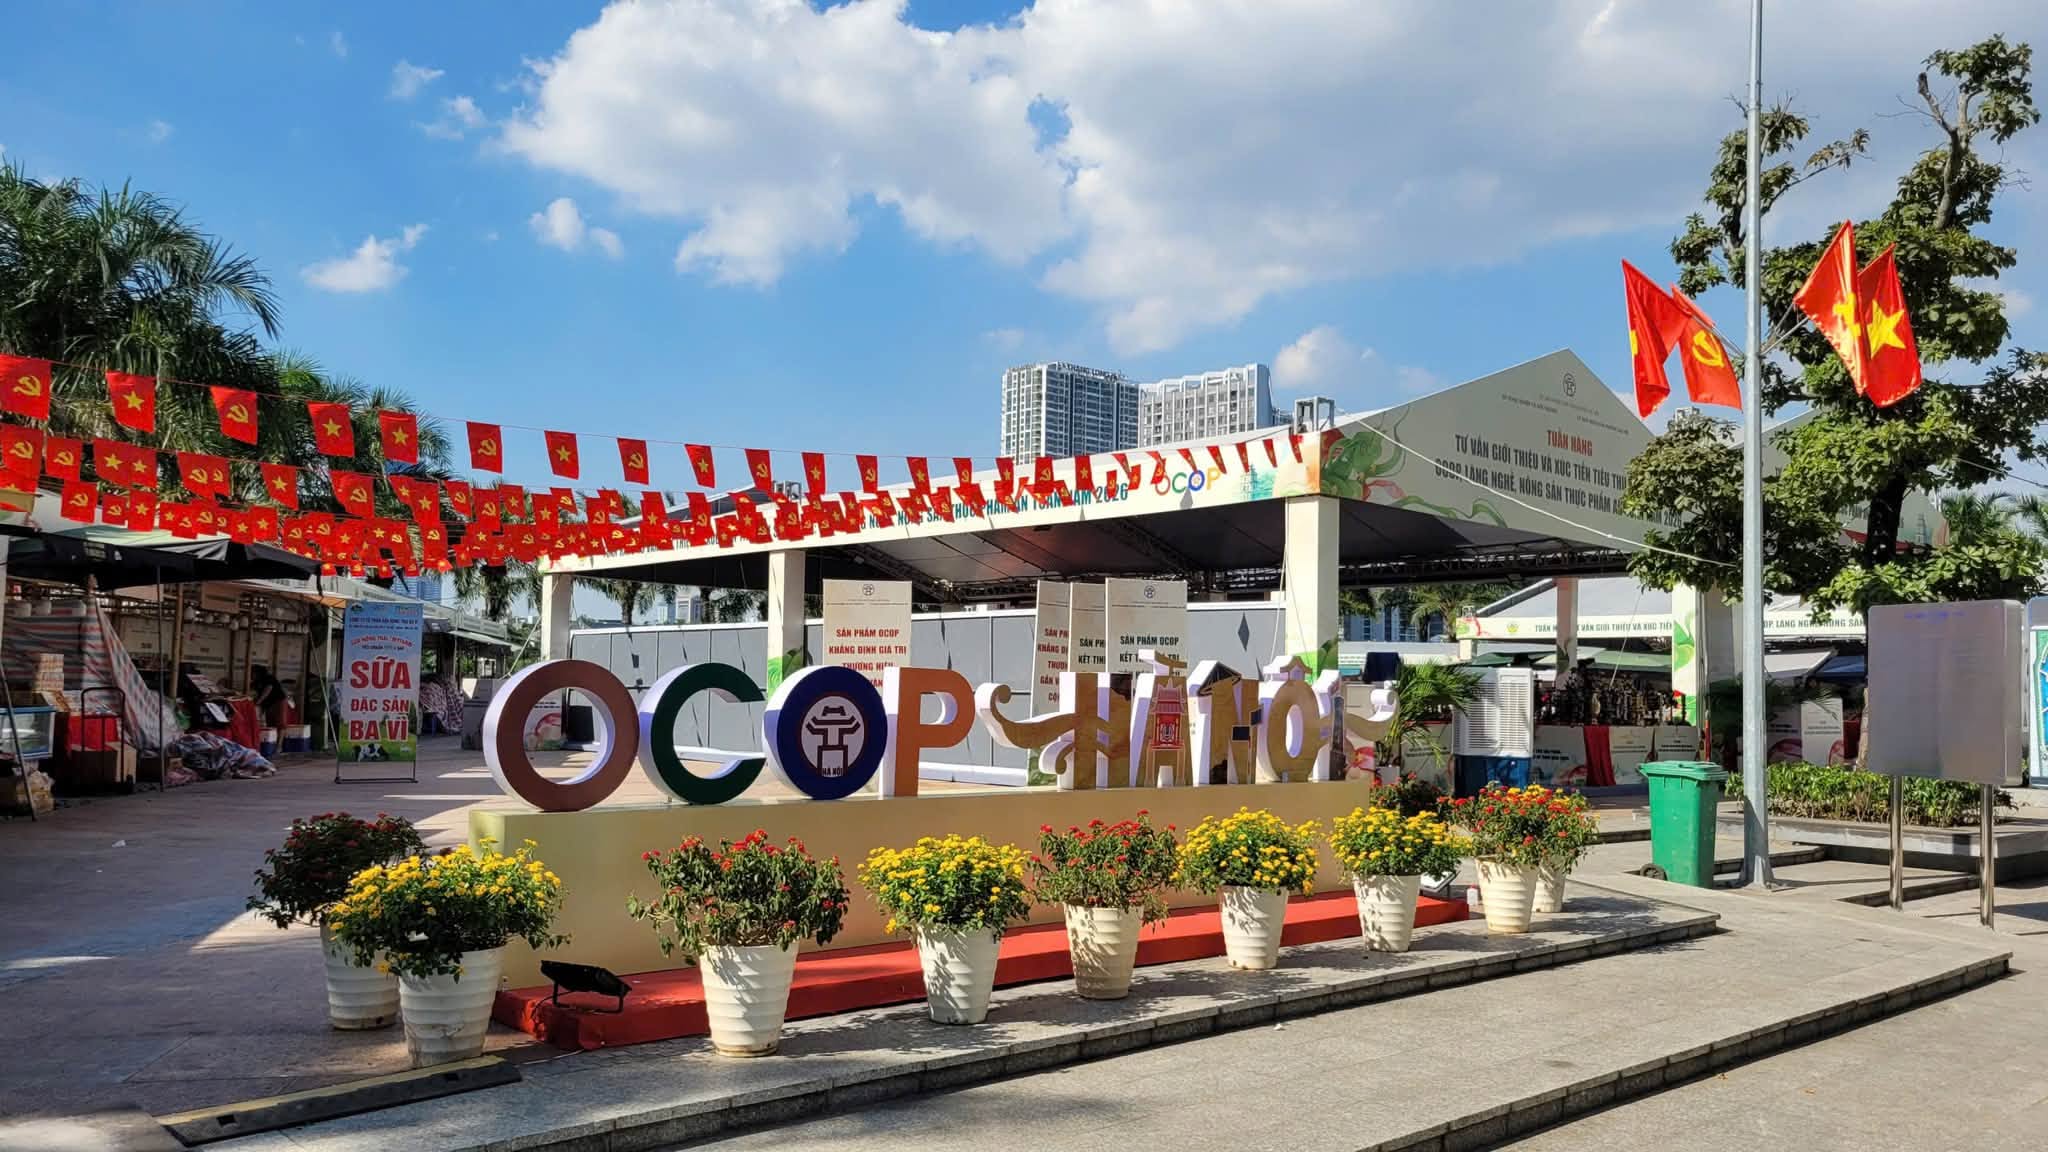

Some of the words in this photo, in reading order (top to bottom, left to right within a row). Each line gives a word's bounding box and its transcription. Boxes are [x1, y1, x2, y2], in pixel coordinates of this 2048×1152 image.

[1155, 466, 1222, 496] OCOP
[836, 626, 852, 638] SẢN
[854, 626, 876, 638] PHẨM
[878, 628, 900, 638] OCOP
[1120, 633, 1135, 645] SẢN
[1137, 632, 1158, 646] PHẨM
[1159, 636, 1180, 646] OCOP
[1080, 636, 1093, 648] SẢN
[895, 645, 907, 656] TRỊ
[1119, 650, 1133, 663] KẾT
[1078, 653, 1091, 665] KẾT
[350, 655, 412, 690] SỮA
[351, 697, 378, 714] ĐẶC
[382, 695, 410, 712] SẢN
[350, 719, 380, 741] BA
[387, 714, 409, 741] VÌ
[484, 656, 975, 812] OCOP
